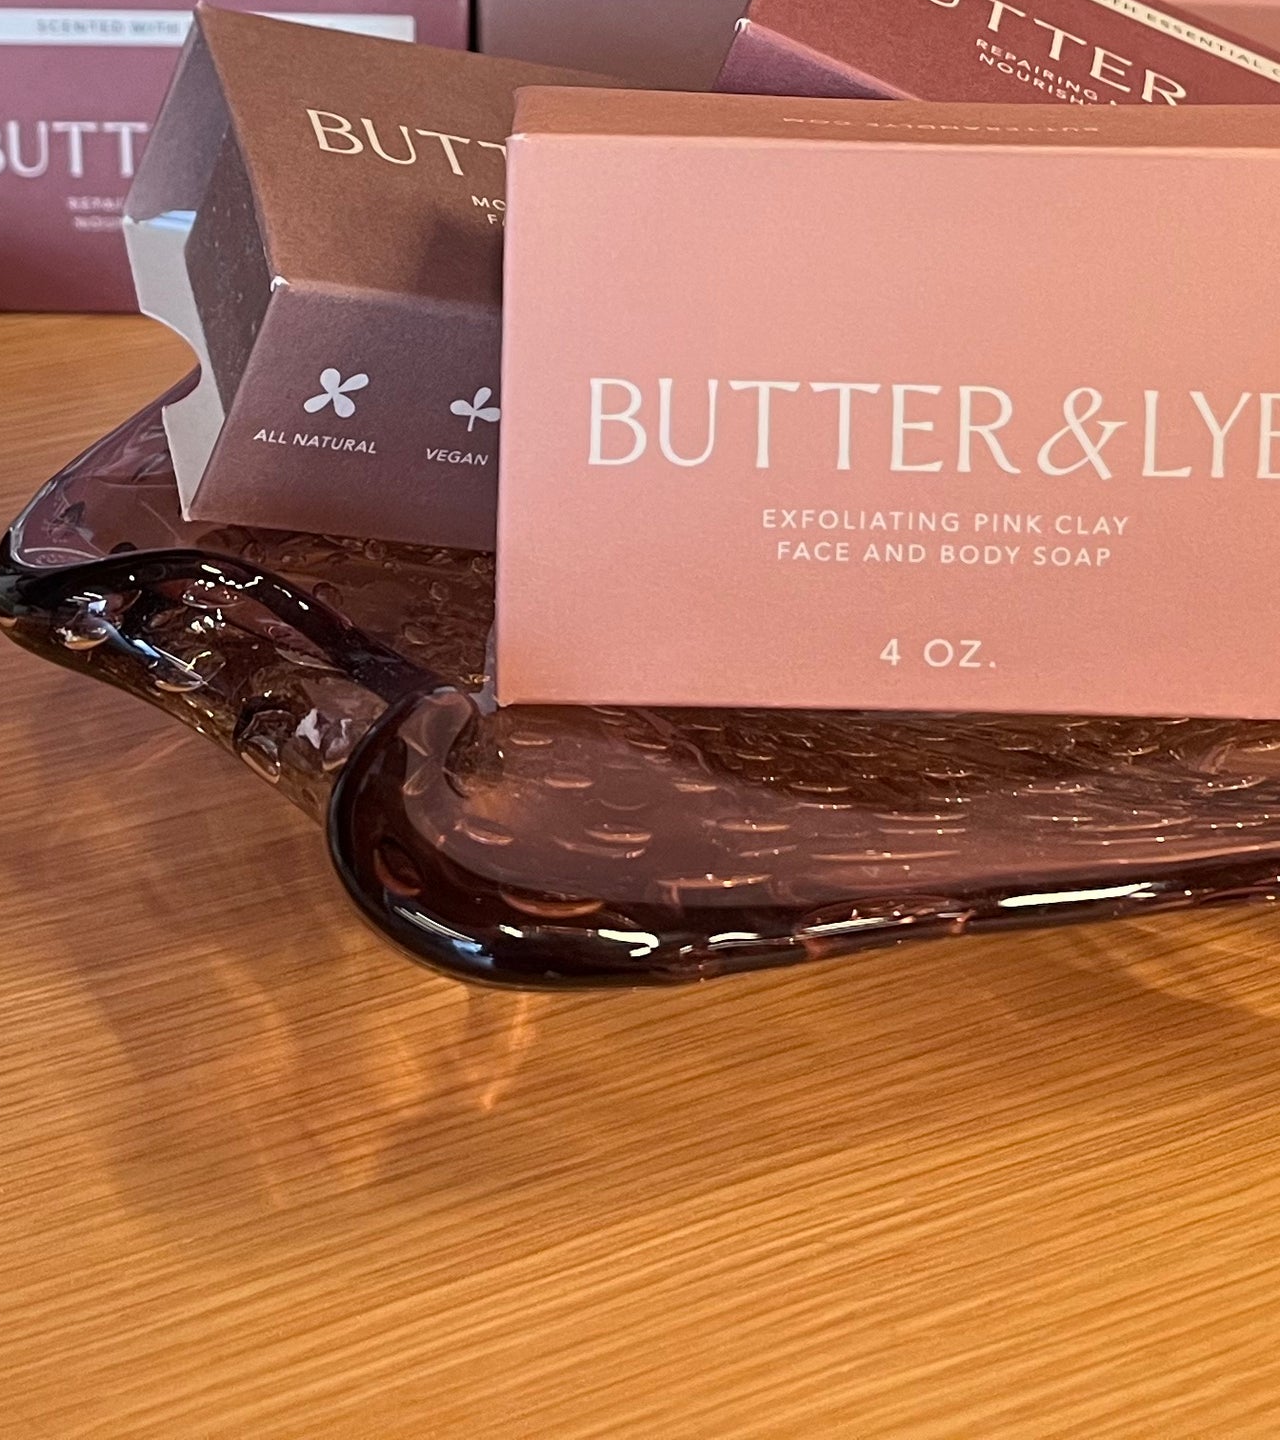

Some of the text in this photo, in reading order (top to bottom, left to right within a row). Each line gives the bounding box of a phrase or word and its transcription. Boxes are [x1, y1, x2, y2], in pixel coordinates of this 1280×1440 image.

[1146, 11, 1264, 70] ESSENTIAL
[976, 38, 1099, 102] REPAIRING
[979, 52, 1094, 106] NOURISH
[253, 428, 489, 467] ALL NATURAL VEGAN
[762, 509, 1129, 536] EXFOLIATING PINK CLAY
[777, 541, 1112, 567] FACE AND BODY SOAP
[879, 637, 997, 669] 4 OZ.
